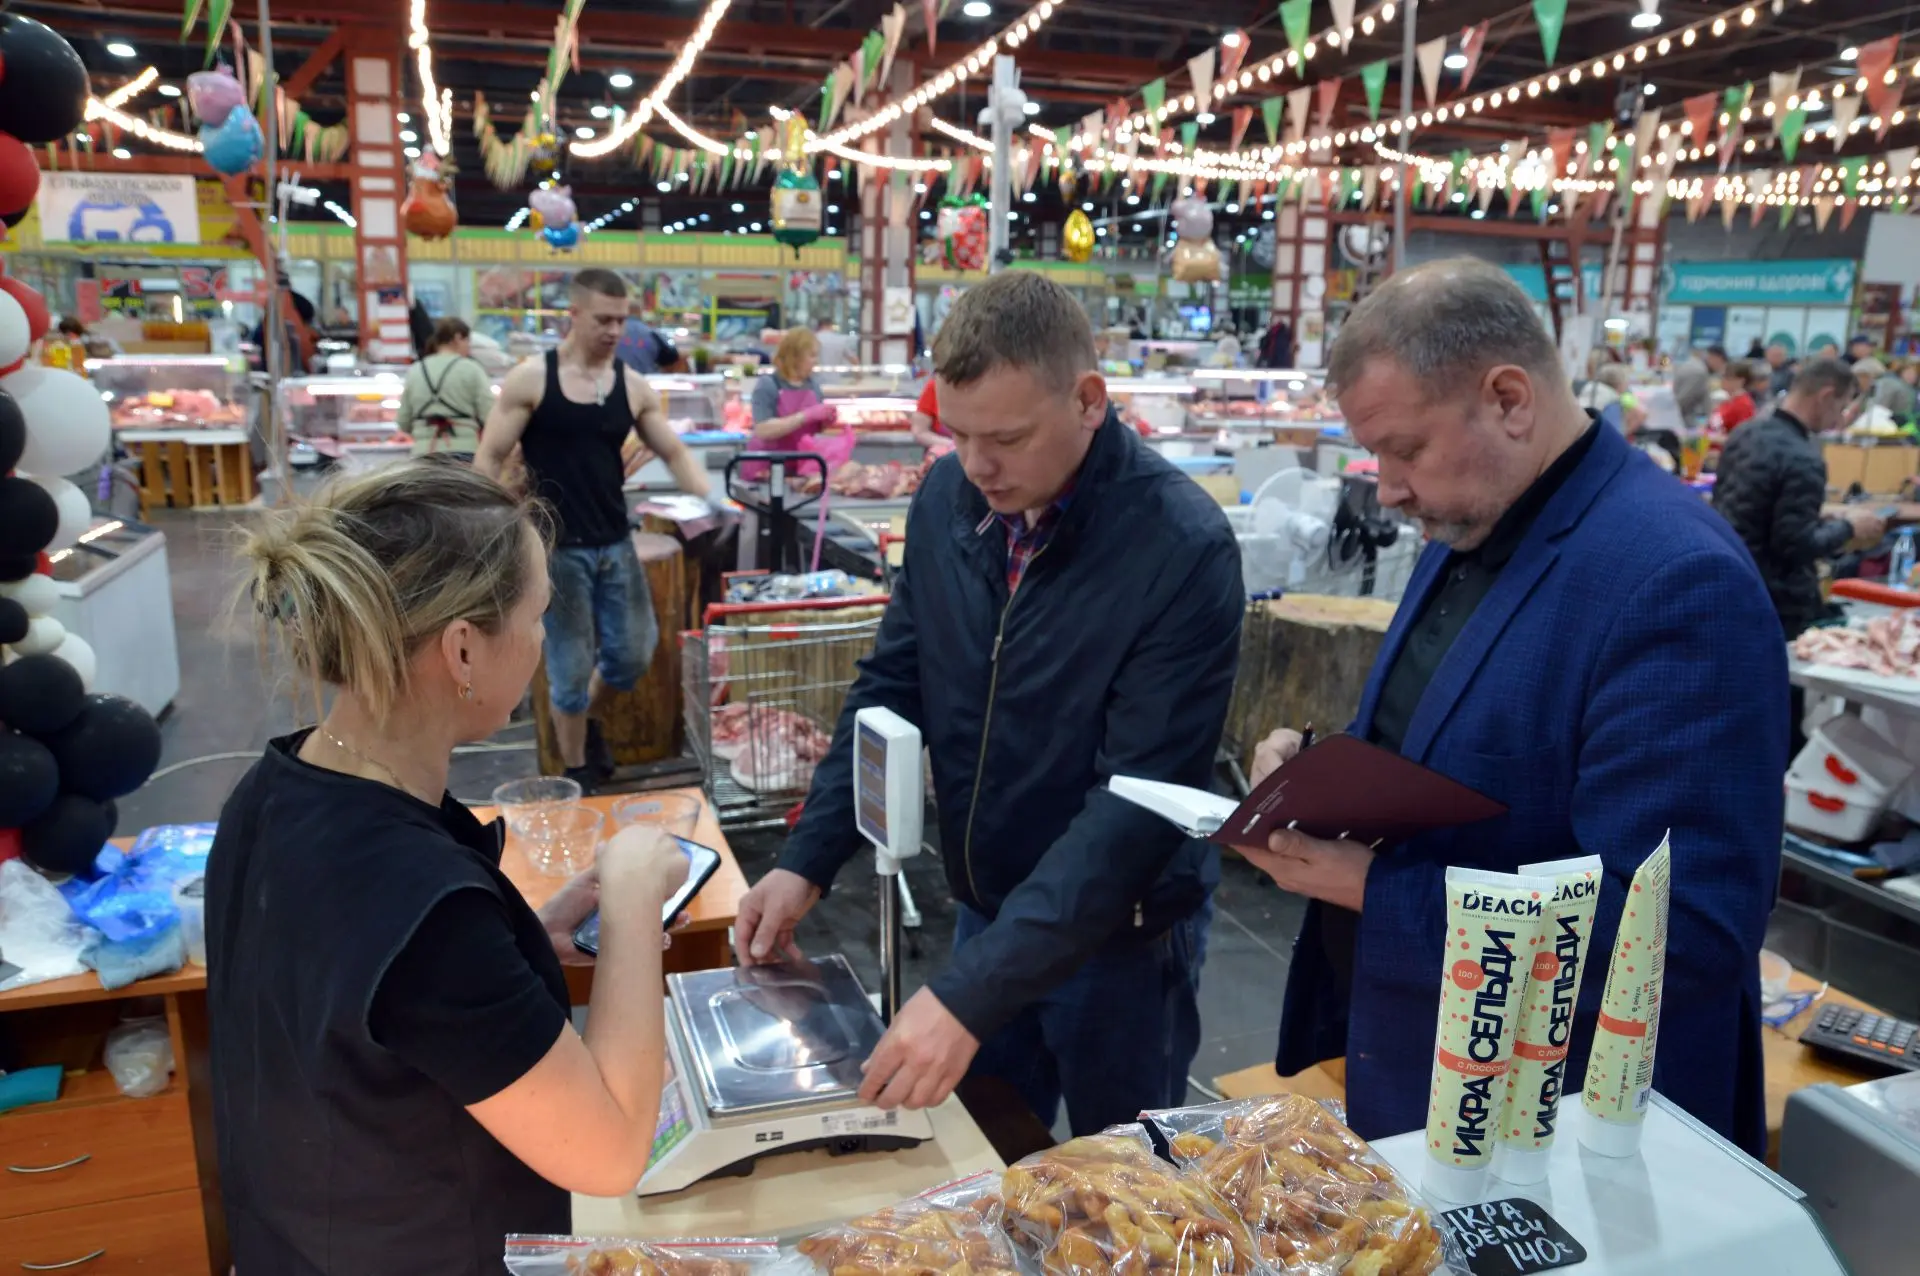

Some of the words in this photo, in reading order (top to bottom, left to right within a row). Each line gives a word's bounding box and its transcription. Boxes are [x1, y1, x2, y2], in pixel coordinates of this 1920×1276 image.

[1457, 970, 1473, 980] 100
[1468, 929, 1517, 1063] СЕЛЬДИ
[1535, 962, 1550, 970] 100
[1548, 914, 1581, 1047] СЕЛЬДИ
[1452, 1075, 1496, 1156] ИКРА
[1533, 1058, 1566, 1138] ИКРА
